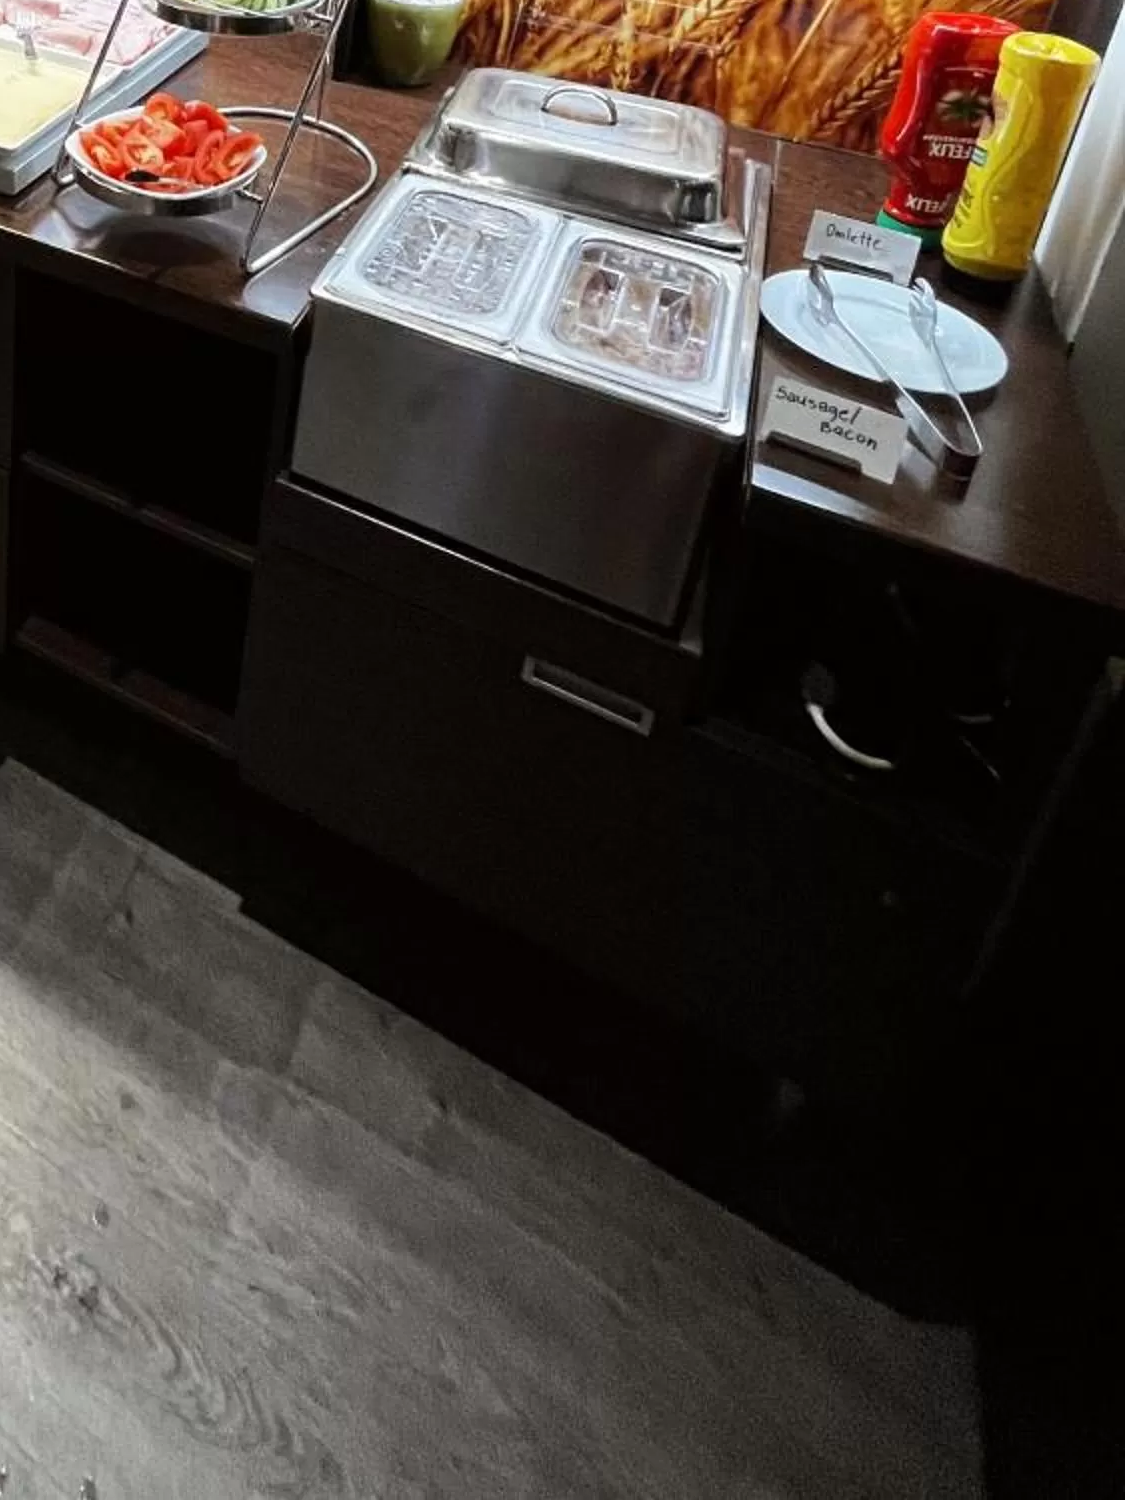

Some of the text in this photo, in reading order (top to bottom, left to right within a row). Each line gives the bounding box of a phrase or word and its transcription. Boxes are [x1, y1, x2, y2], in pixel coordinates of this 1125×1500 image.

[927, 141, 973, 160] FELIX
[904, 193, 952, 214] FELIX
[819, 420, 878, 451] Bacon
